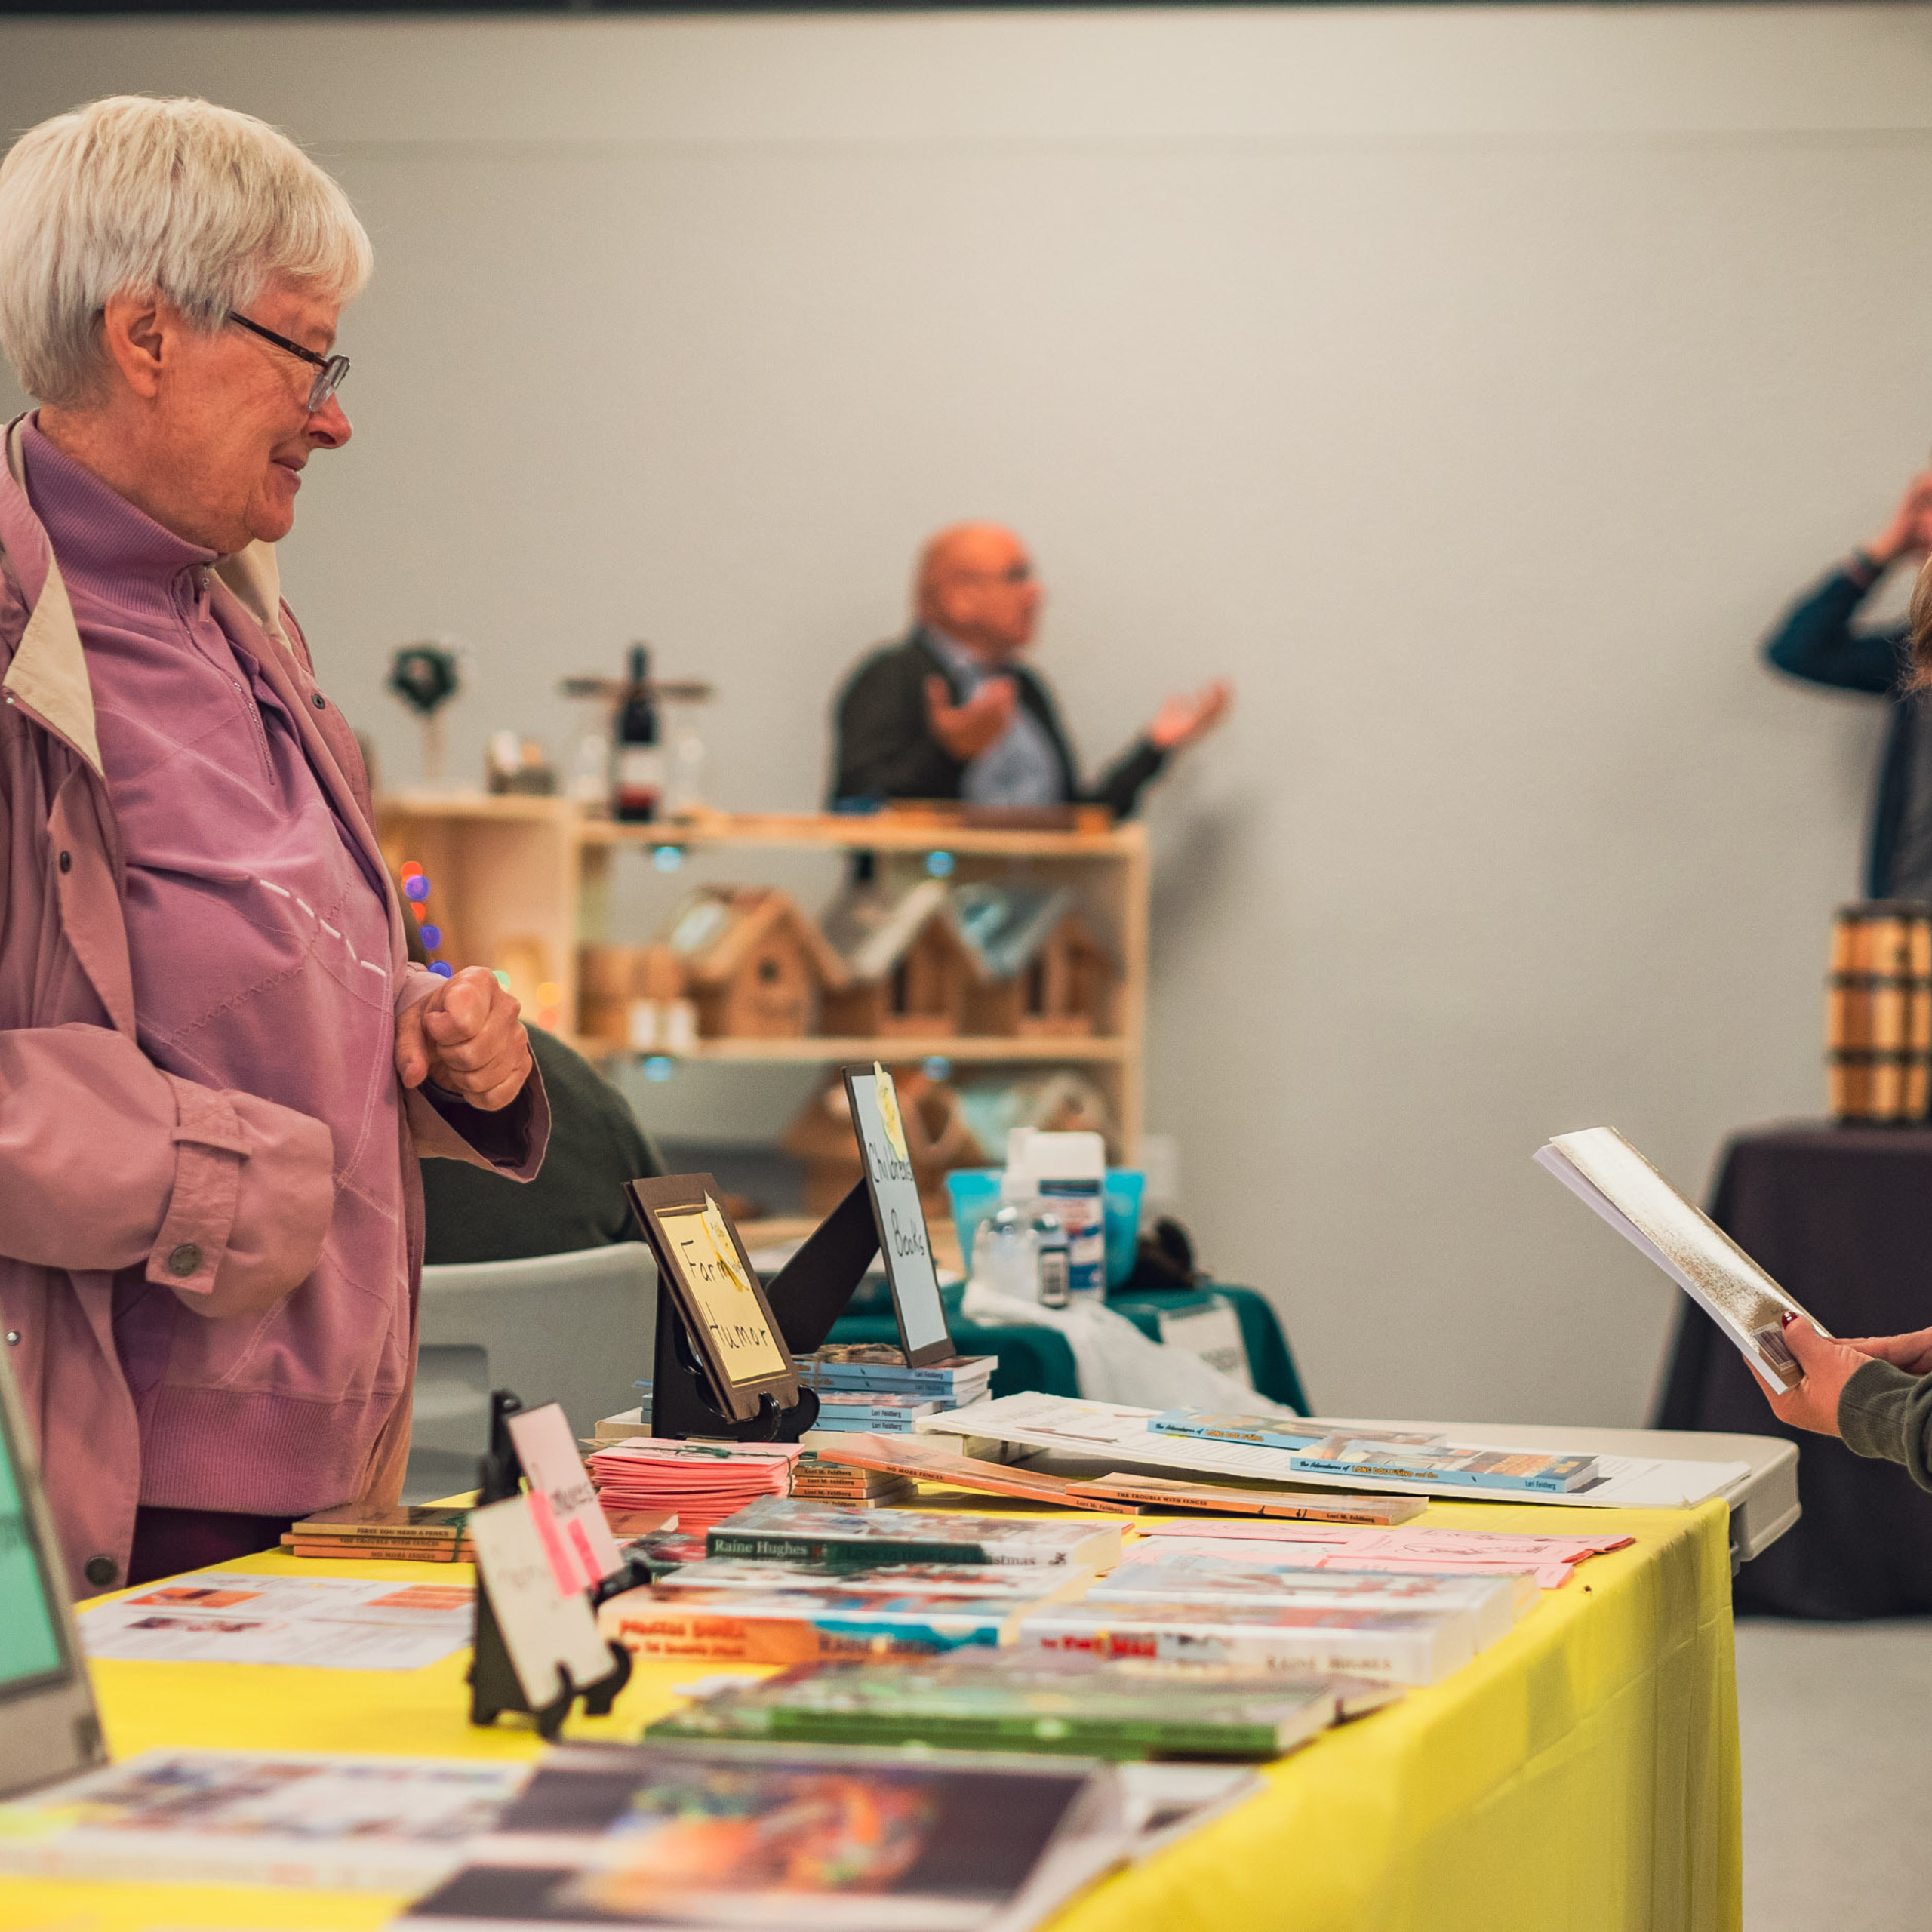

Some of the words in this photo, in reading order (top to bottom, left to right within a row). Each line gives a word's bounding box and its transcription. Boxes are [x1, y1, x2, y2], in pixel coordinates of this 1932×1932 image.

[891, 1208, 925, 1257] Books
[681, 1240, 737, 1286] Farm
[698, 1300, 768, 1349] Humor
[1310, 1462, 1341, 1470] Adventures
[1131, 1493, 1161, 1501] TROUBLE
[715, 1538, 752, 1553] Raine
[756, 1540, 808, 1557] Hughes
